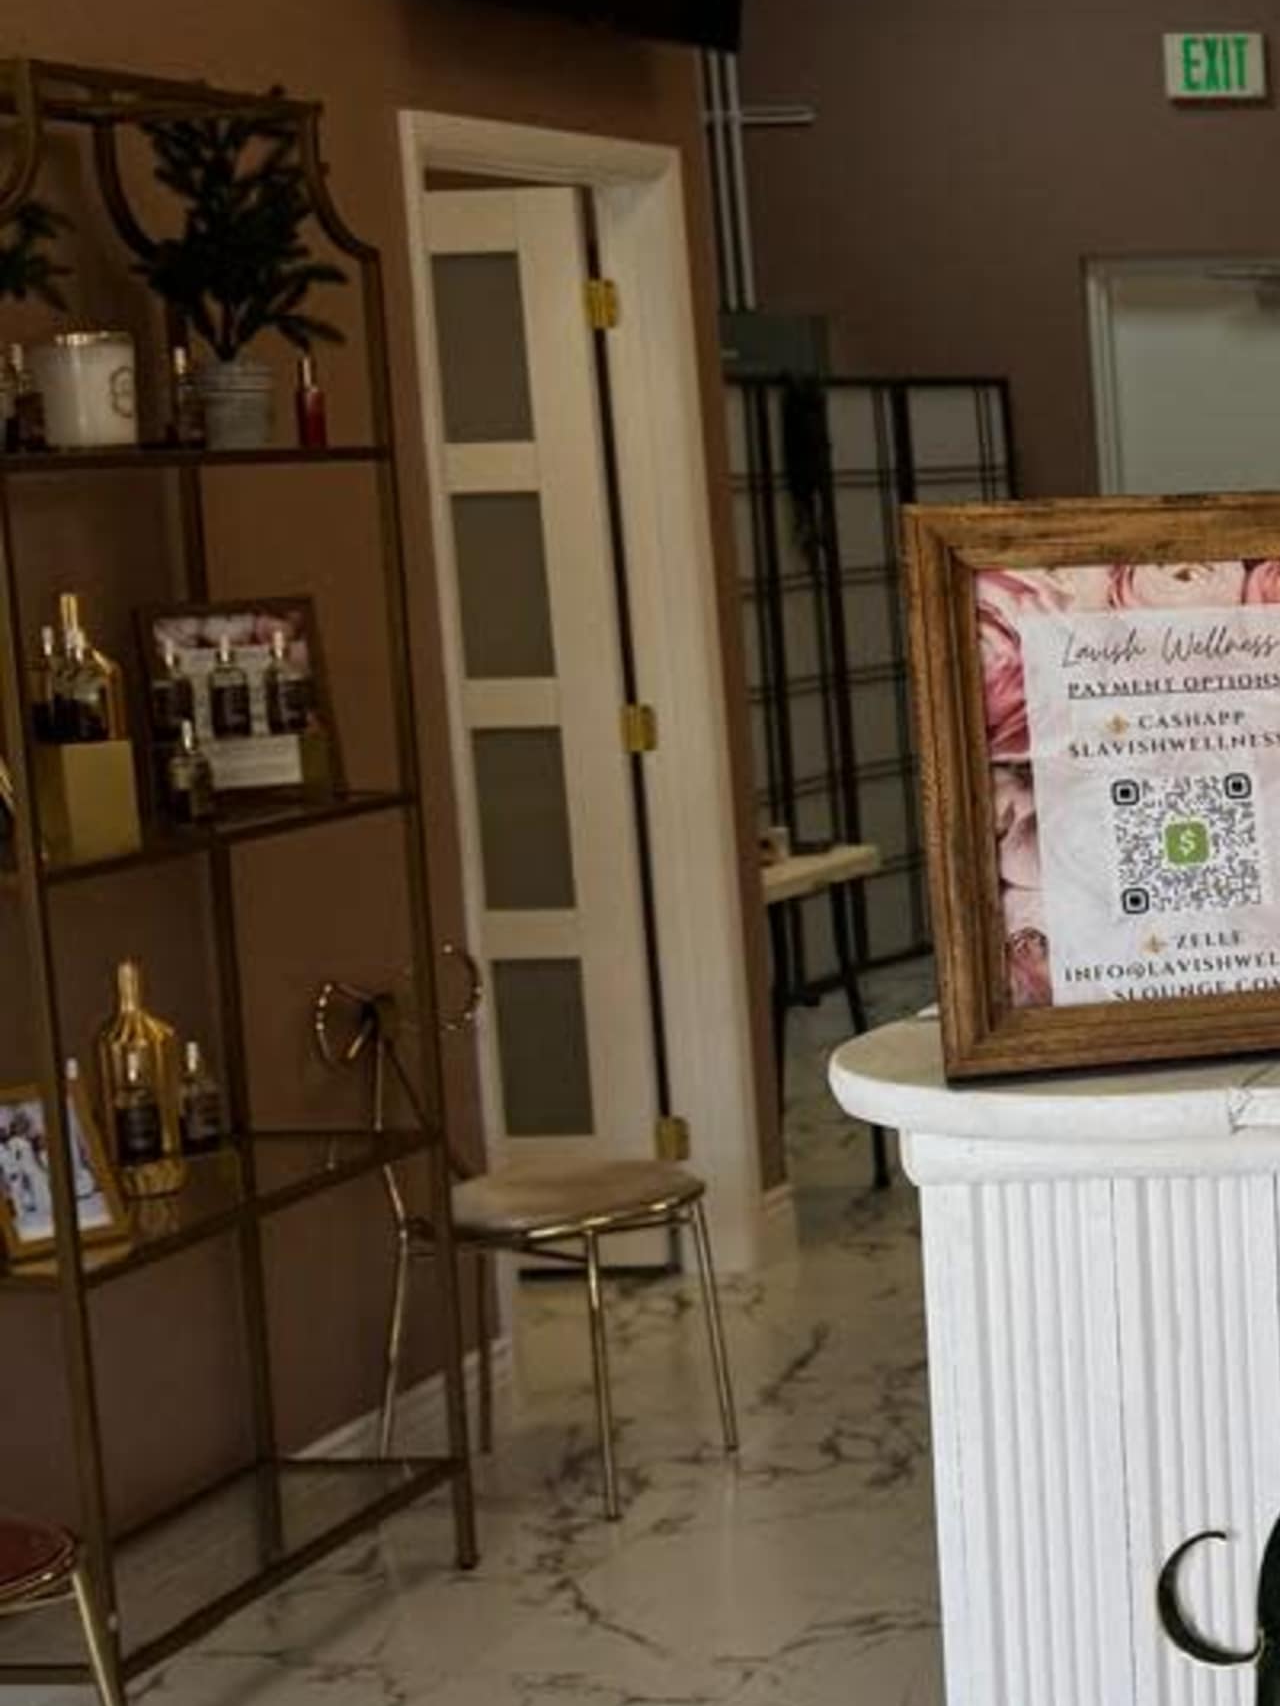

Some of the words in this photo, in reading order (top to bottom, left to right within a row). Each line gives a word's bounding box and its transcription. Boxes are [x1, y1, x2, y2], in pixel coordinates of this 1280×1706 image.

[1181, 34, 1250, 91] EXIT
[1062, 628, 1146, 667] Lavish
[1161, 624, 1280, 665] Wellness
[1068, 678, 1173, 699] PAYMENT
[1138, 710, 1246, 729] CASHAPP
[1176, 929, 1241, 949] ZELLE
